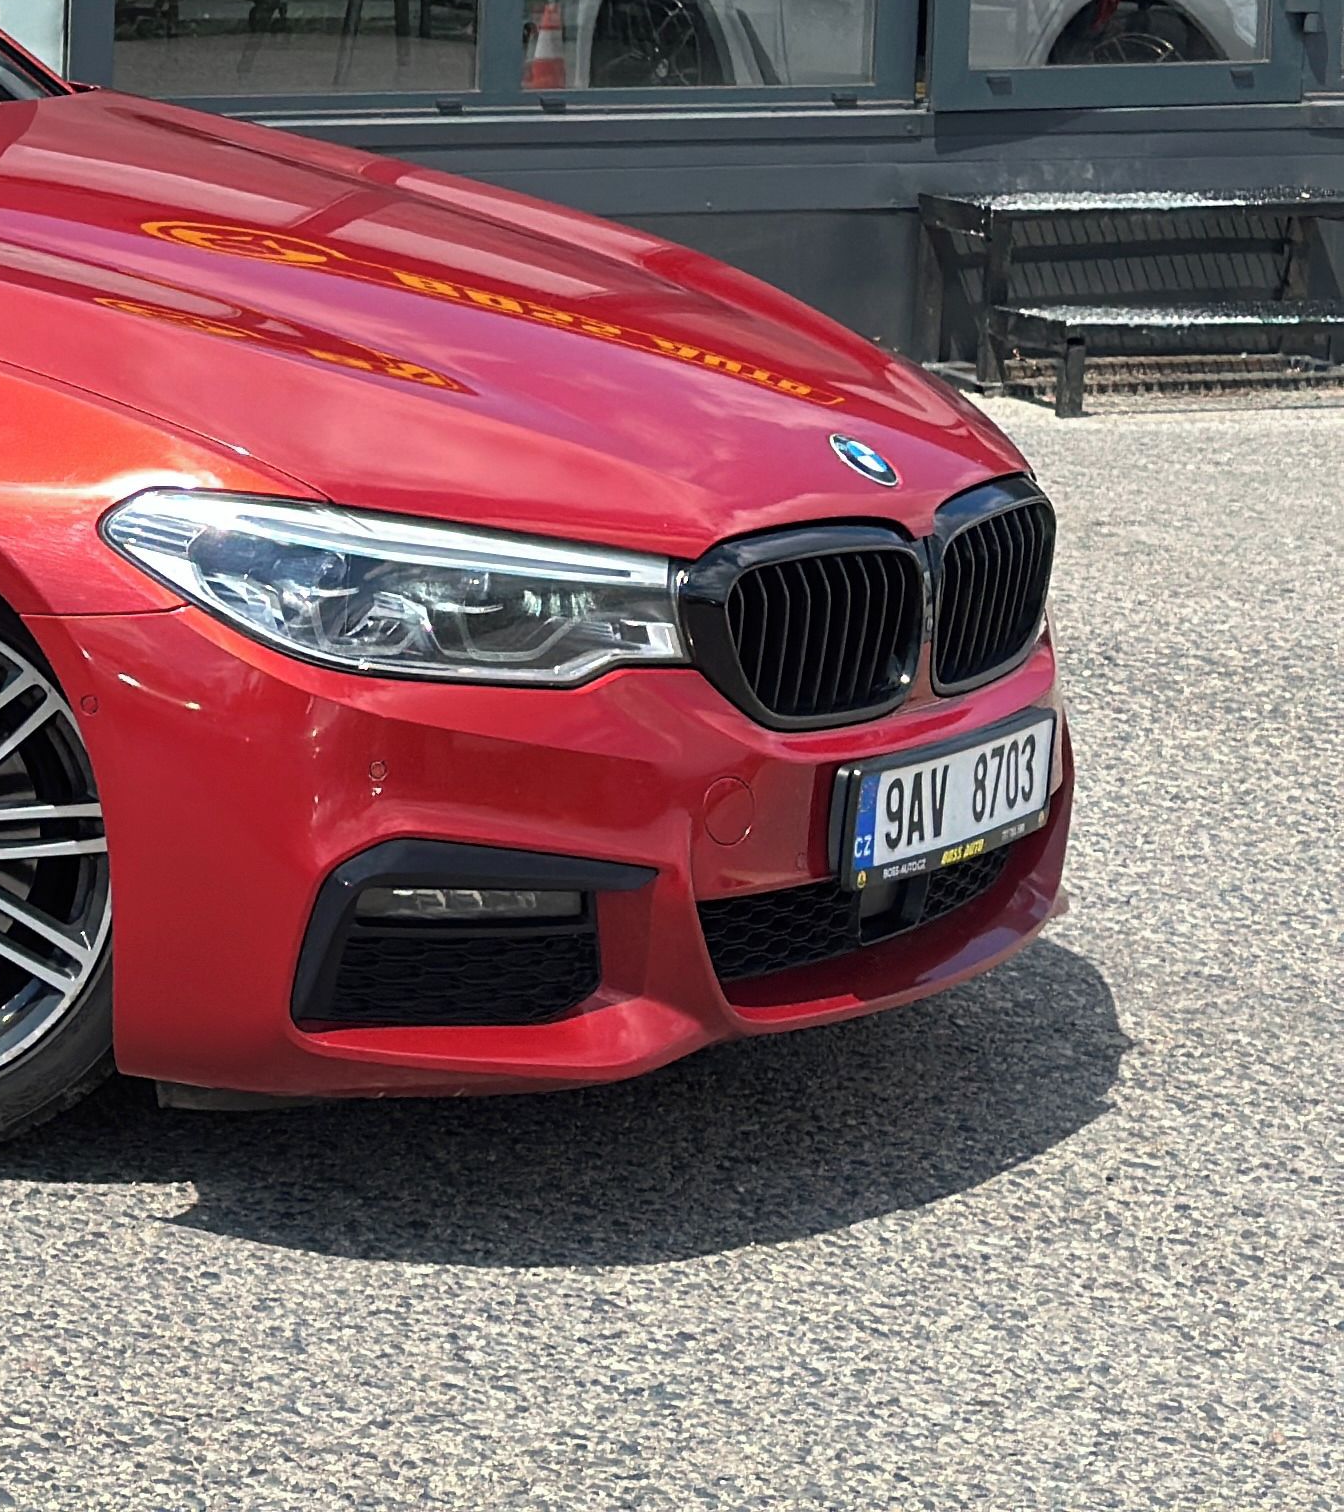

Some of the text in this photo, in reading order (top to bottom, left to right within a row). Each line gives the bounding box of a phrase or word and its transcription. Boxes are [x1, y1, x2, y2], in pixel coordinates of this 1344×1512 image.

[884, 733, 1036, 851] 9AV 8703
[854, 835, 871, 858] CZ
